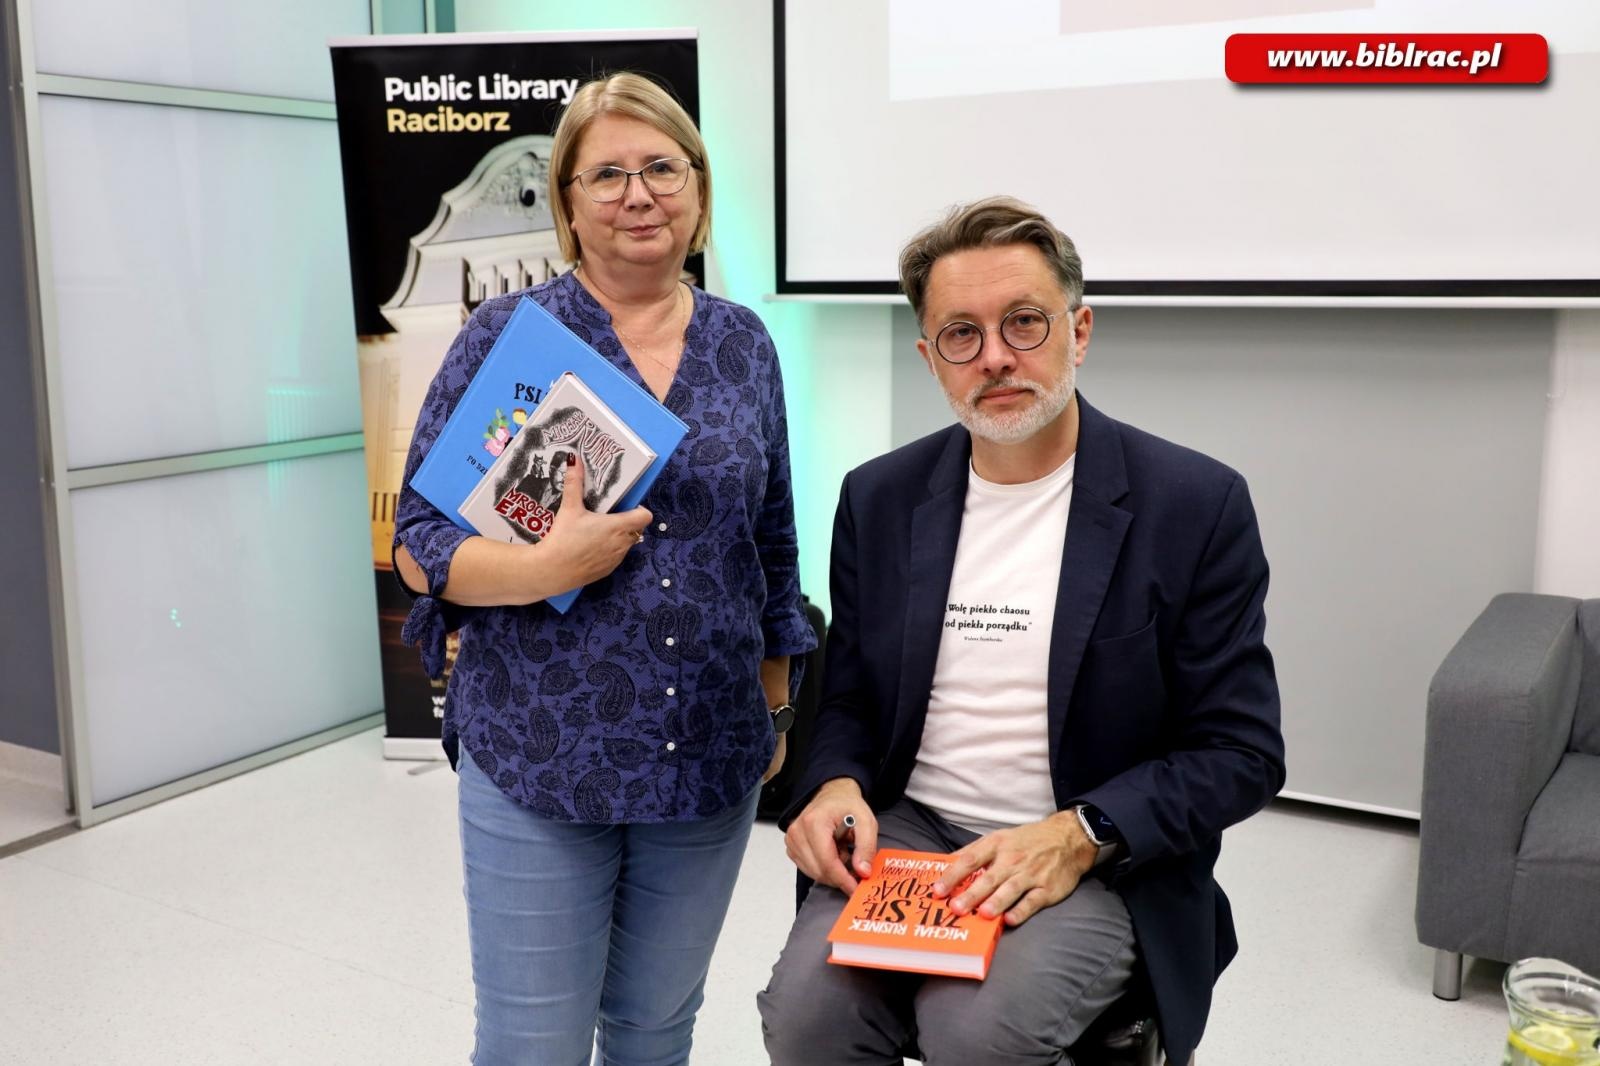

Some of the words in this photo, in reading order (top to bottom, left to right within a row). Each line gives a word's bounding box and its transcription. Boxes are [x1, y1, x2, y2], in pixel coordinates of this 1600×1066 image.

[384, 74, 472, 102] Public
[479, 73, 579, 105] Library
[386, 106, 511, 133] Raciborz
[513, 382, 548, 404] PSI
[504, 486, 555, 527] MROCZN
[970, 604, 998, 616] piekło
[999, 605, 1030, 616] chaosu
[945, 618, 956, 628] od
[958, 620, 984, 631] piekła
[848, 919, 907, 936] RUSINEK
